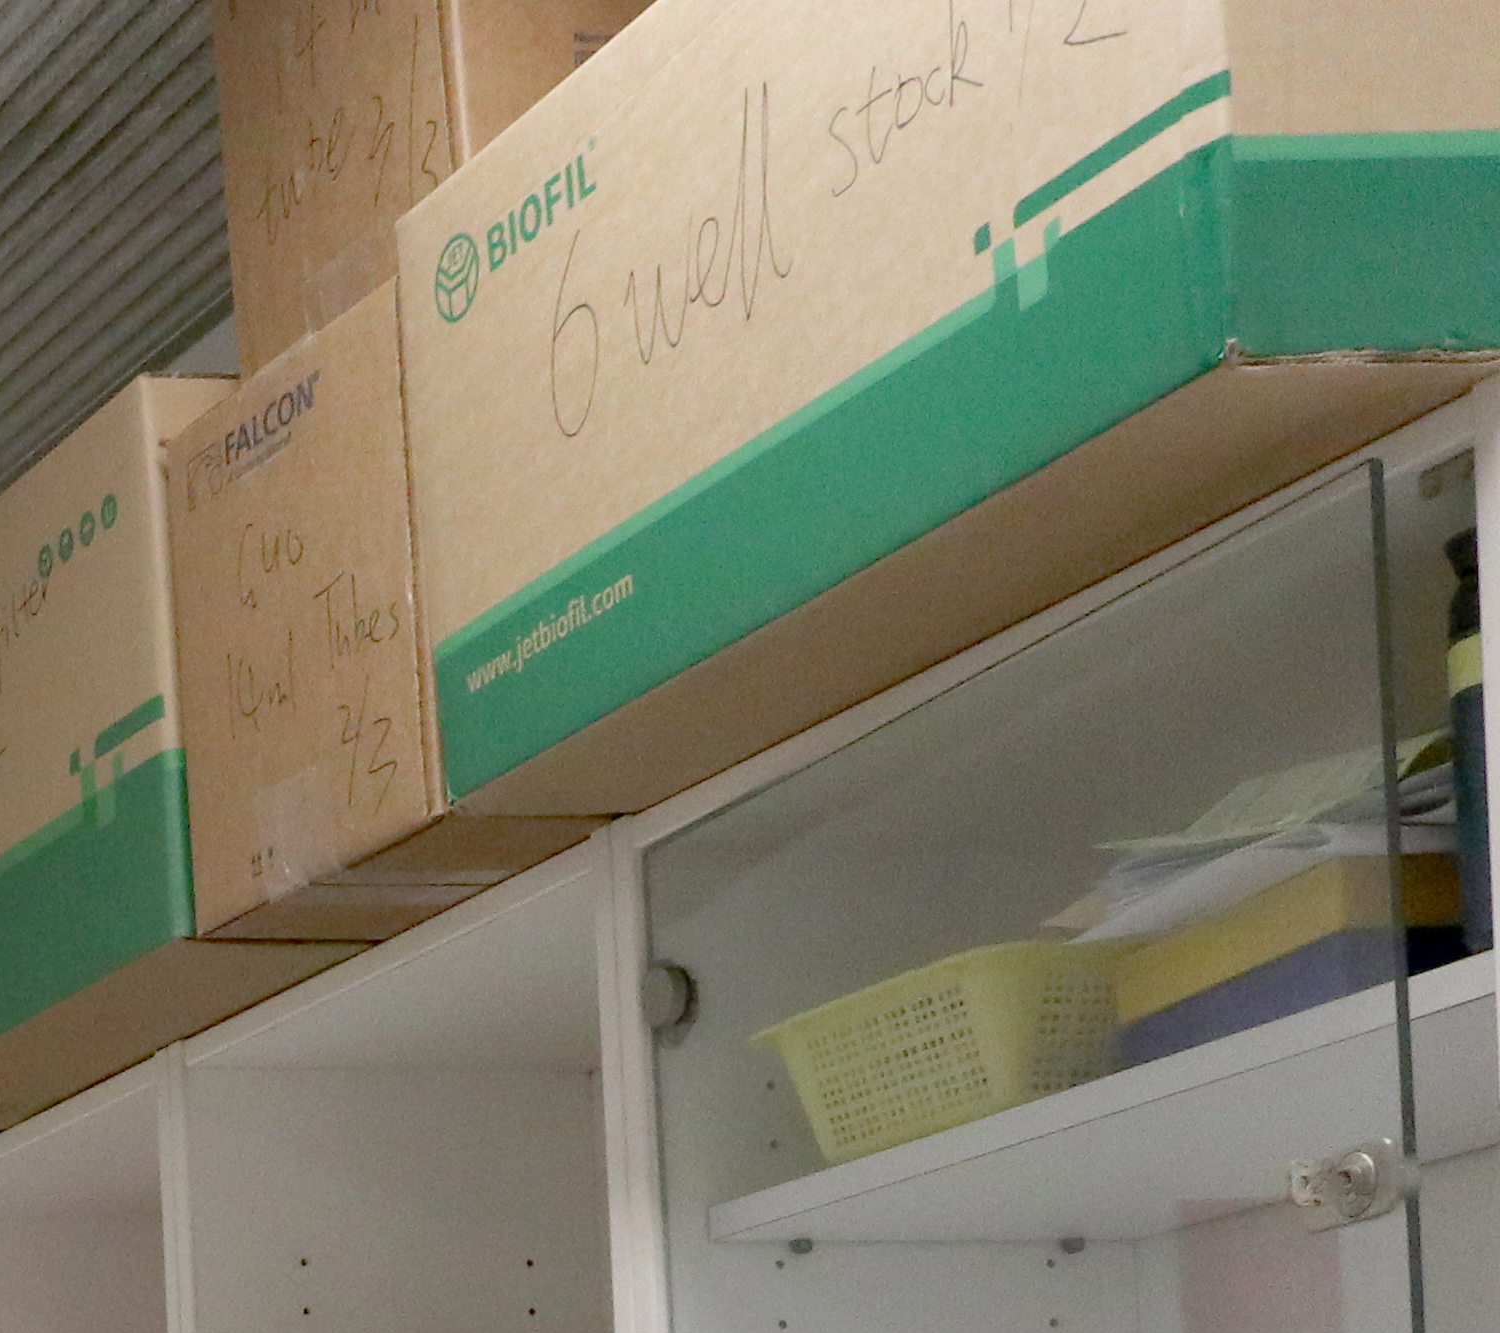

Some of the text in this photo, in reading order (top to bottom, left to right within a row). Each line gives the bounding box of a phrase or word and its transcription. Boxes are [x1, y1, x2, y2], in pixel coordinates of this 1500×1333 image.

[485, 155, 597, 272] BIOFIL
[625, 83, 790, 365] well
[831, 0, 983, 197] stock
[222, 376, 317, 467] FALCON
[467, 575, 634, 693] www.jetbiofil.com
